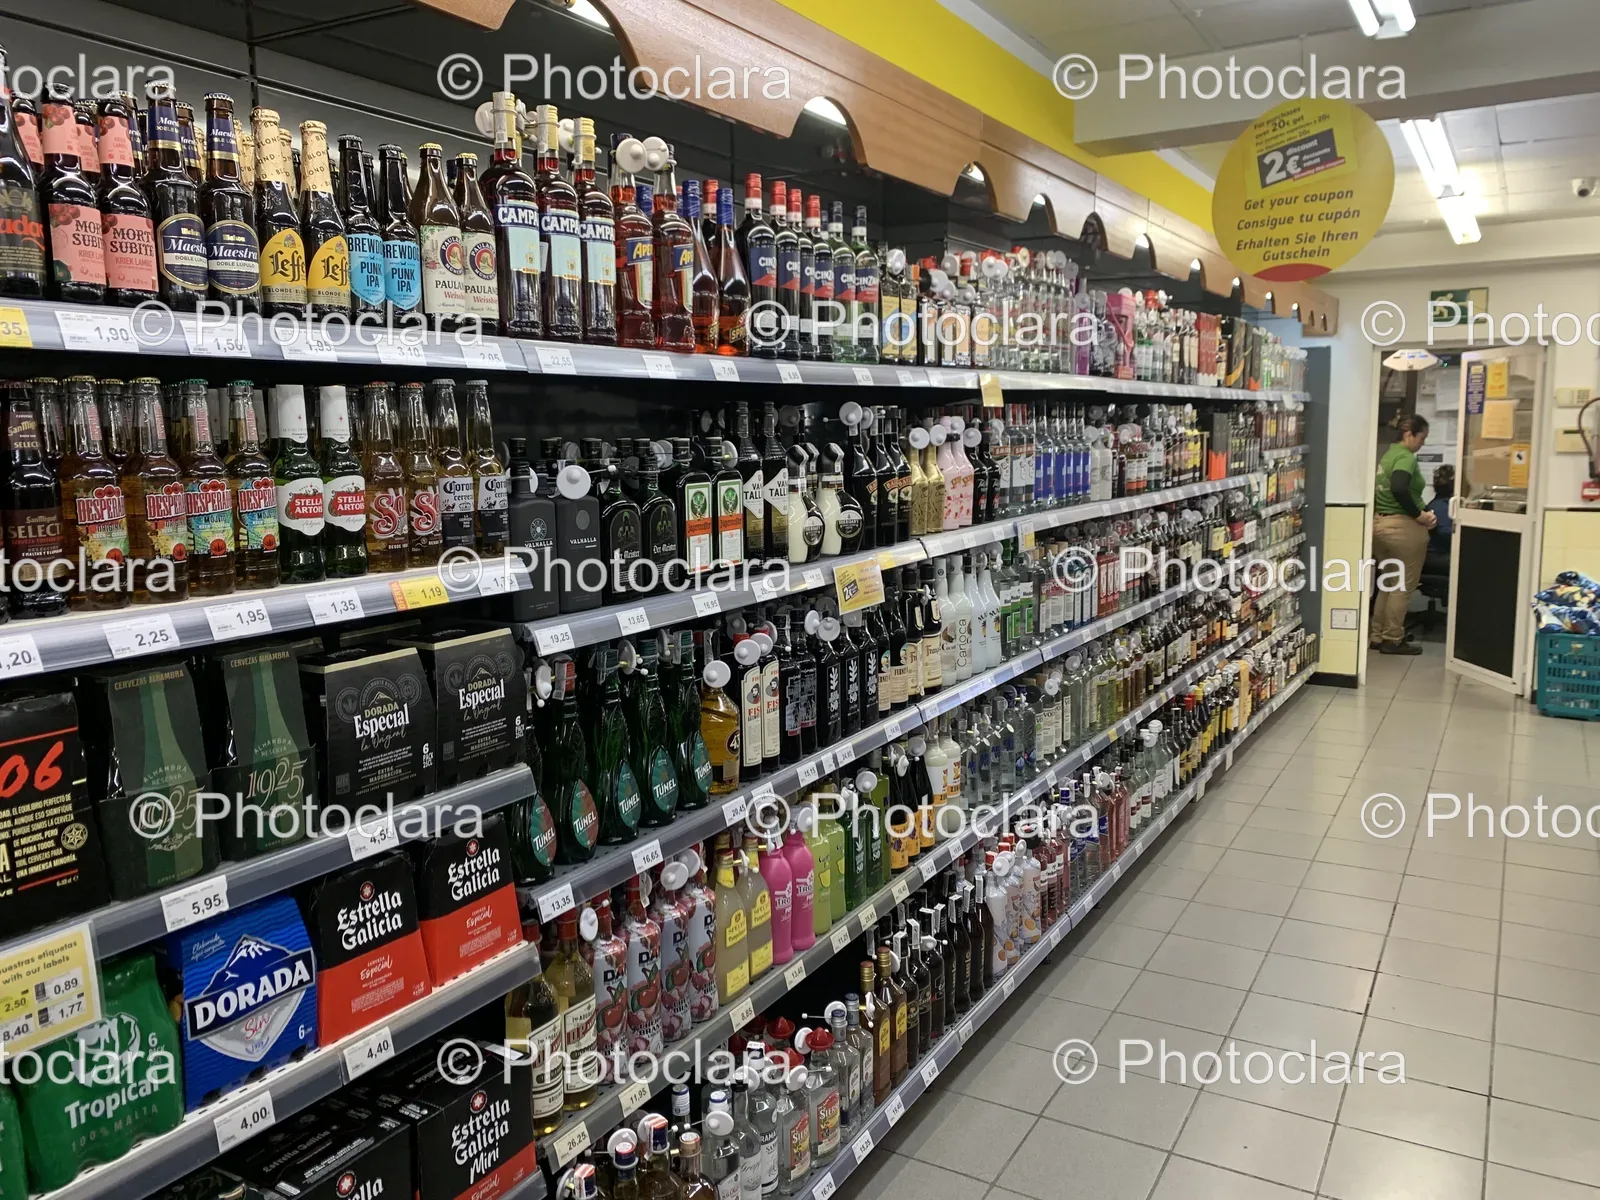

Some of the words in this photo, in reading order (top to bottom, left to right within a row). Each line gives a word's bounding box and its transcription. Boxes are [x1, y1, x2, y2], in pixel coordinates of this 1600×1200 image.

[1286, 138, 1318, 156] discount
[1263, 150, 1302, 185] 2€
[1244, 199, 1265, 211] Get
[1270, 195, 1299, 210] your
[1304, 188, 1354, 205] coupon
[1237, 214, 1294, 231] Consigue
[1300, 212, 1313, 224] tu
[1318, 207, 1361, 223] cupón
[1236, 235, 1289, 252] Erhalten
[1295, 232, 1316, 245] Sie
[1322, 229, 1358, 243] Ihren
[209, 244, 258, 260] Maestra
[1263, 247, 1330, 262] Gutschein
[360, 261, 382, 275] PUNK
[391, 267, 416, 281] PUNK
[366, 275, 380, 288] IPA
[397, 280, 412, 293] IPA
[94, 326, 129, 343] 1,90
[550, 355, 572, 367] 22,55
[569, 536, 597, 545] VALHALLA
[421, 586, 442, 600] 1,19
[331, 599, 356, 615] 1,35
[703, 600, 718, 610] 16,95
[236, 608, 265, 625] 1,95
[135, 629, 169, 647] 2,25
[550, 632, 570, 643] 19,25
[957, 619, 967, 667] Carioca
[230, 655, 258, 668] CERVEZAS
[114, 675, 147, 691] CERVEZAS
[467, 678, 497, 692] DORADA
[459, 679, 505, 710] Especial
[364, 702, 399, 718] DORADA
[353, 703, 409, 739] Especial
[515, 715, 521, 726] 6
[422, 743, 429, 754] 6
[378, 765, 394, 776] EXTRA
[246, 758, 308, 807] 1925
[43, 795, 65, 807] PERFECTO
[31, 820, 47, 831] SOMOS
[48, 818, 54, 827] LA
[54, 813, 75, 825] CERVEZA
[35, 811, 45, 820] ESO
[44, 828, 59, 838] PERO
[14, 849, 22, 858] NO
[23, 845, 37, 855] PARA
[28, 851, 50, 864] CERVEZAS
[51, 848, 63, 857] PARA
[642, 852, 659, 864] 16,65
[16, 868, 28, 878] UNA
[28, 861, 52, 875] INMENSA
[447, 847, 501, 885] Estrella
[451, 866, 501, 902] Galicia
[192, 894, 222, 915] 5,95
[337, 890, 403, 933] Estrella
[551, 896, 571, 912] 13,35
[466, 905, 493, 929] Especial
[341, 912, 403, 951] Galicia
[37, 940, 78, 961] etiquetas
[2, 973, 23, 985] with
[25, 966, 41, 977] our
[43, 955, 70, 970] labels
[360, 955, 393, 980] Especial
[53, 977, 79, 995] 0,89
[194, 959, 311, 1030] DORADA
[4, 997, 27, 1013] 2,50
[59, 1001, 83, 1019] 1,77
[2, 1023, 29, 1041] 8,40
[244, 1013, 271, 1040] Sin
[298, 1024, 305, 1040] 6
[148, 1032, 158, 1048] 6
[366, 1039, 390, 1060] 4,40
[64, 1075, 160, 1129] Tropical
[630, 1088, 647, 1104] 11,95
[114, 1103, 159, 1133] MALTA
[240, 1106, 268, 1130] 4,00
[451, 1098, 511, 1149] Estrella
[454, 1119, 510, 1166] Galicia
[568, 1133, 588, 1150] 26,25
[470, 1145, 500, 1184] Mini
